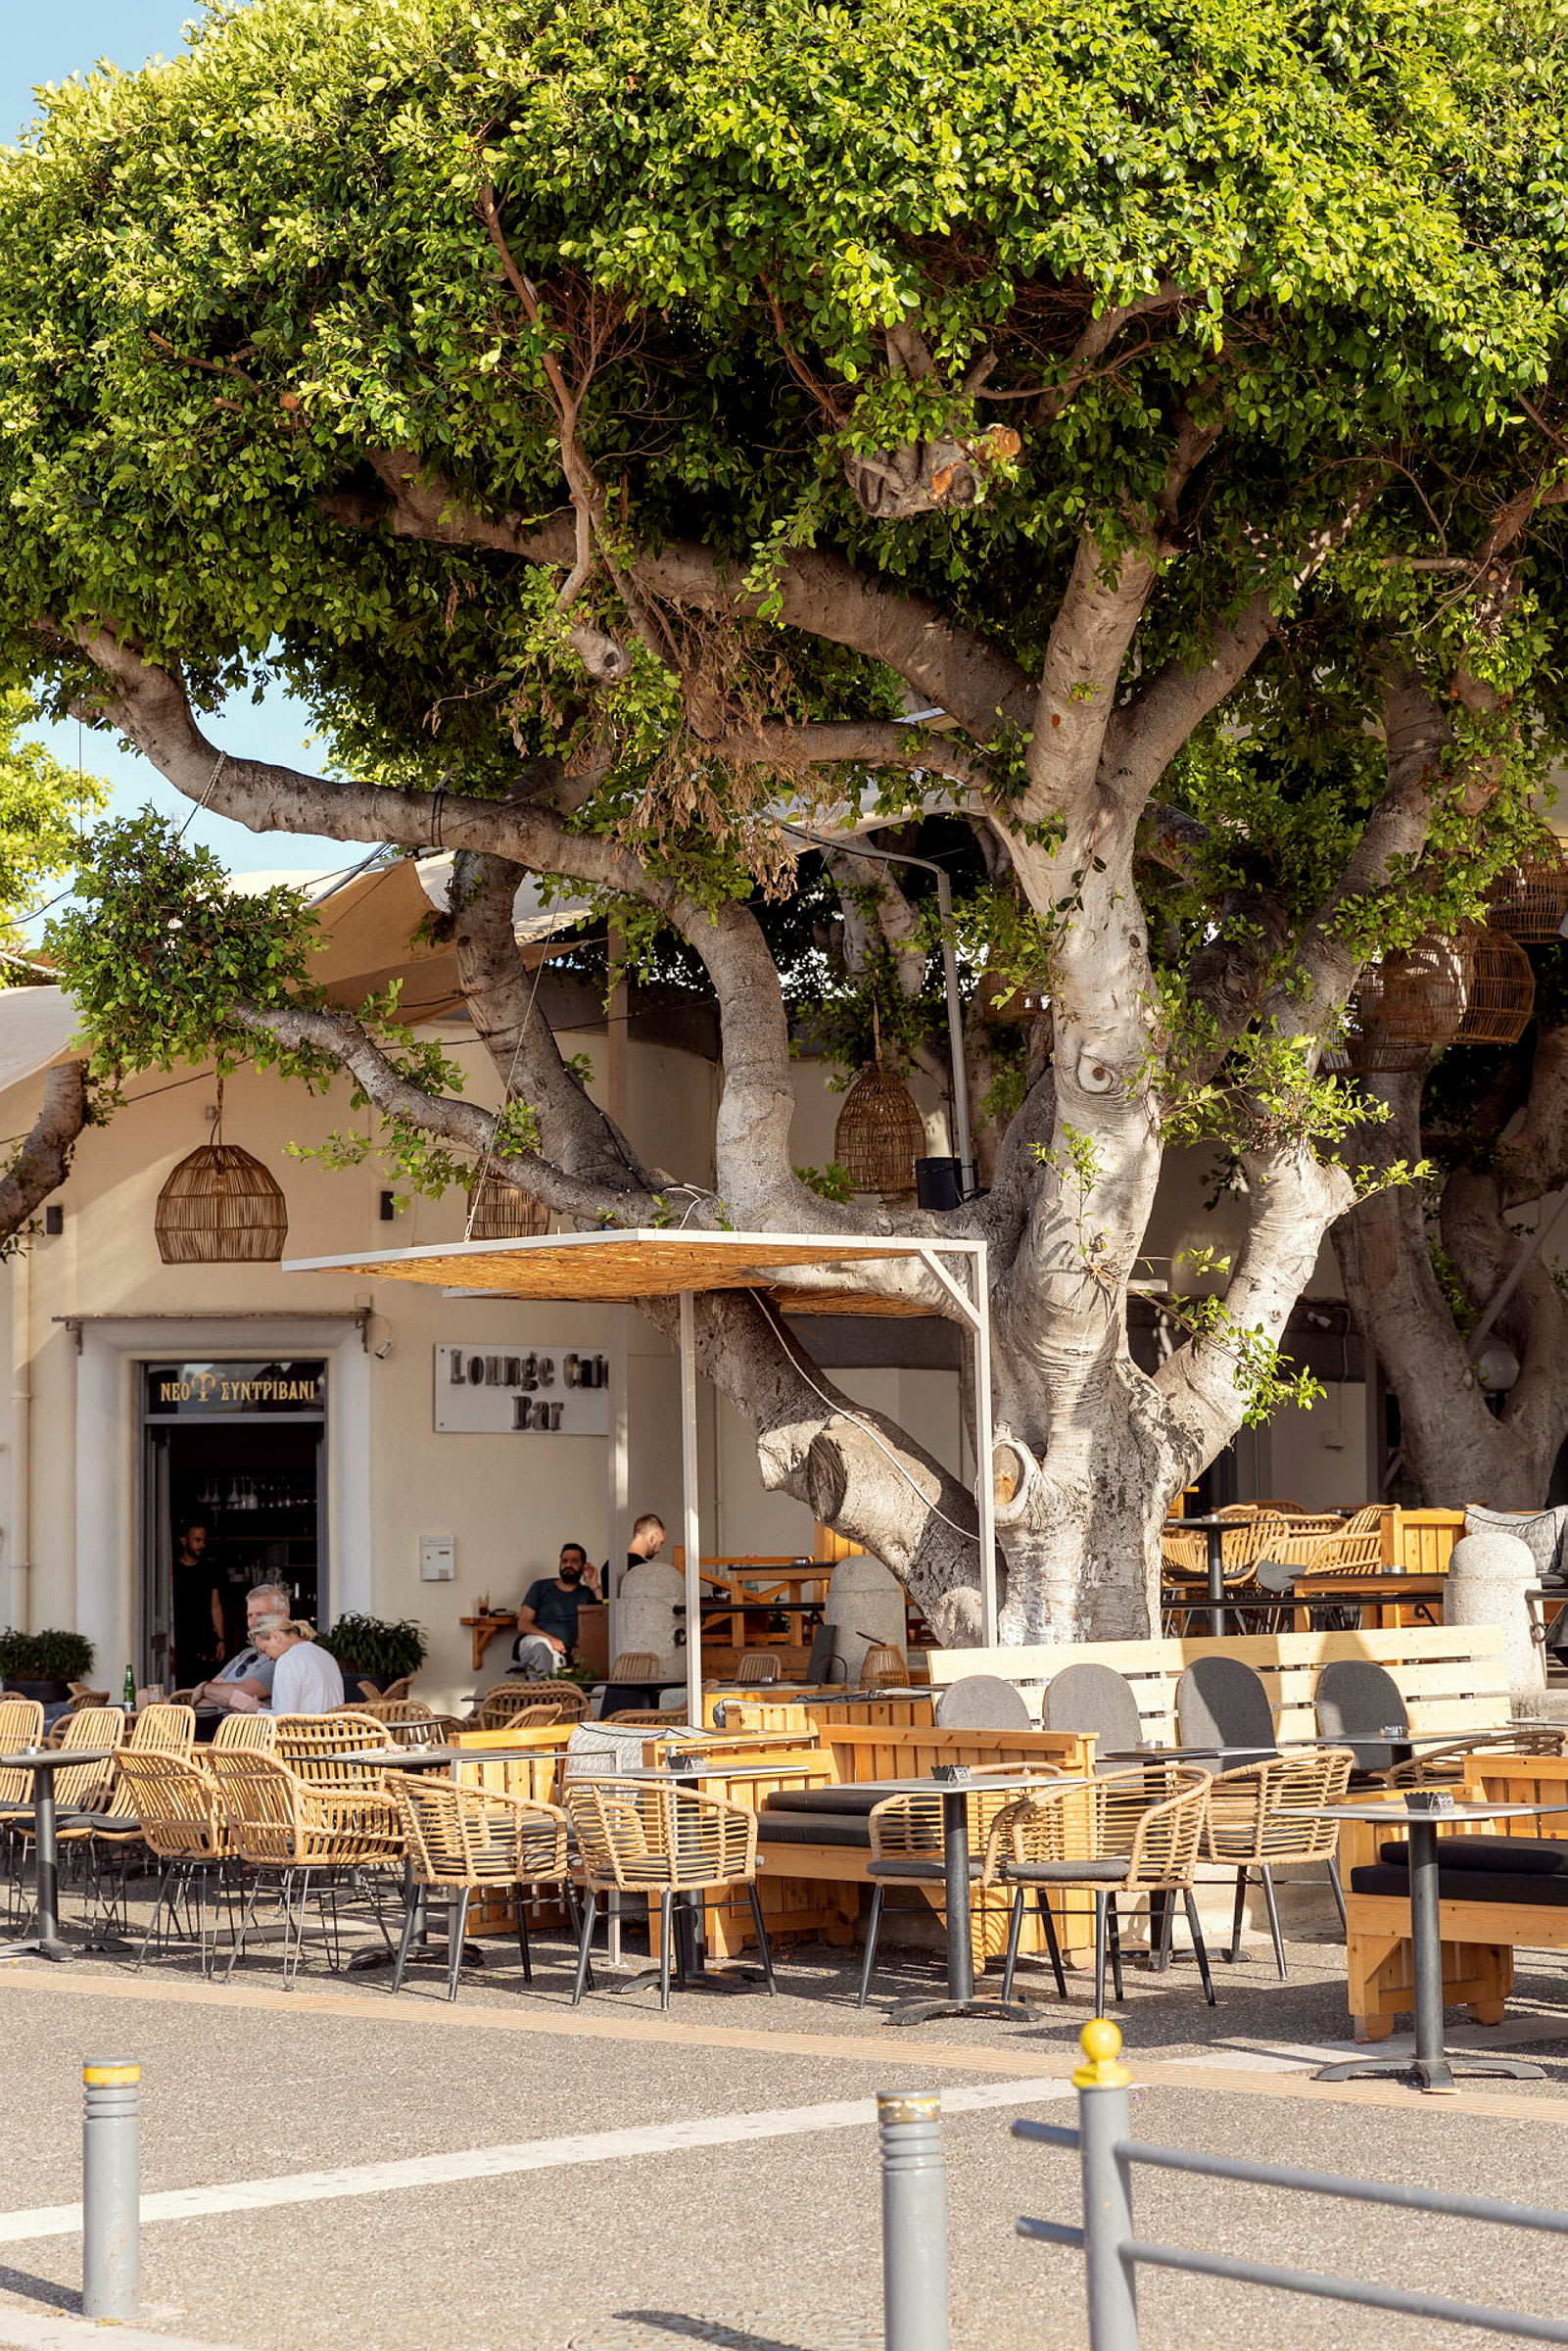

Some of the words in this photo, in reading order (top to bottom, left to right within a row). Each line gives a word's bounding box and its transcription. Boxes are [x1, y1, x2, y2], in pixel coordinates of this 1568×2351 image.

[450, 1349, 554, 1391] Lounge
[161, 1382, 190, 1402] ΝΕΟ
[220, 1381, 315, 1401] ΣΥΝΤΡΙΒΑΝΙ
[510, 1395, 564, 1431] Bar
